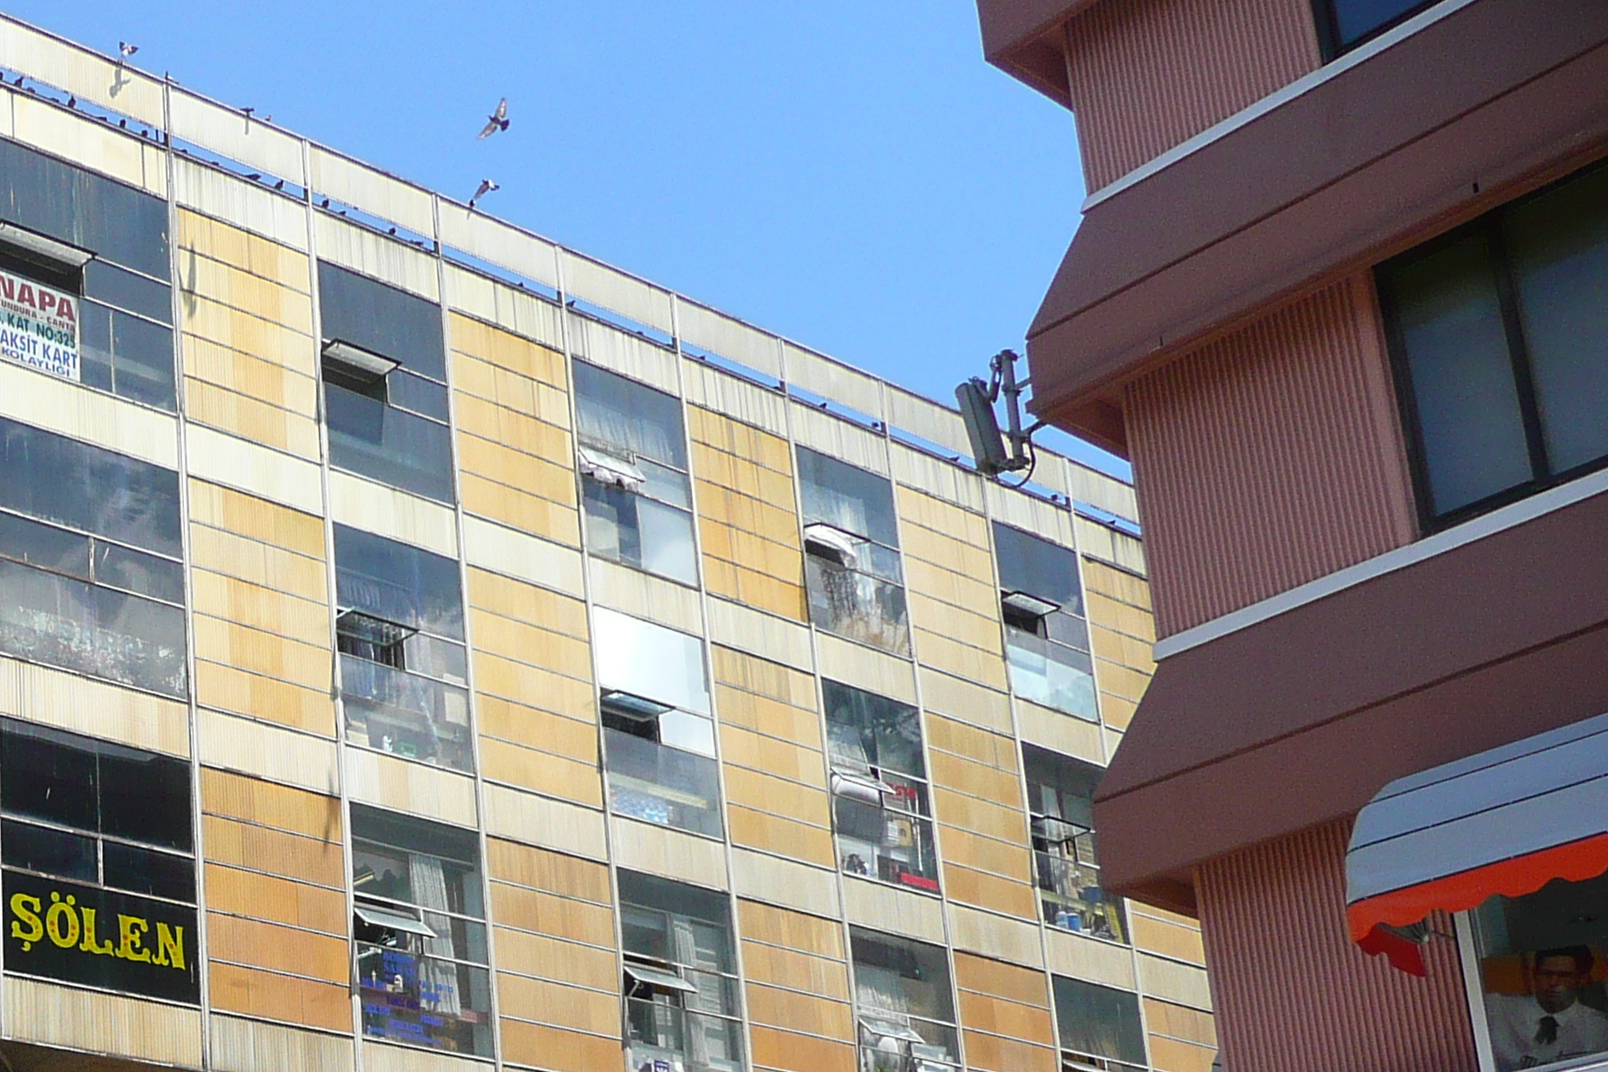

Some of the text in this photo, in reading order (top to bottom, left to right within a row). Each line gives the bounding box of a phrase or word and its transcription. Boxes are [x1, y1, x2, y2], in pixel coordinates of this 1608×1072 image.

[7, 313, 30, 331] KAT
[36, 323, 76, 349] NO:325
[42, 343, 78, 369] KART
[10, 891, 186, 971] ŞÖLEN
